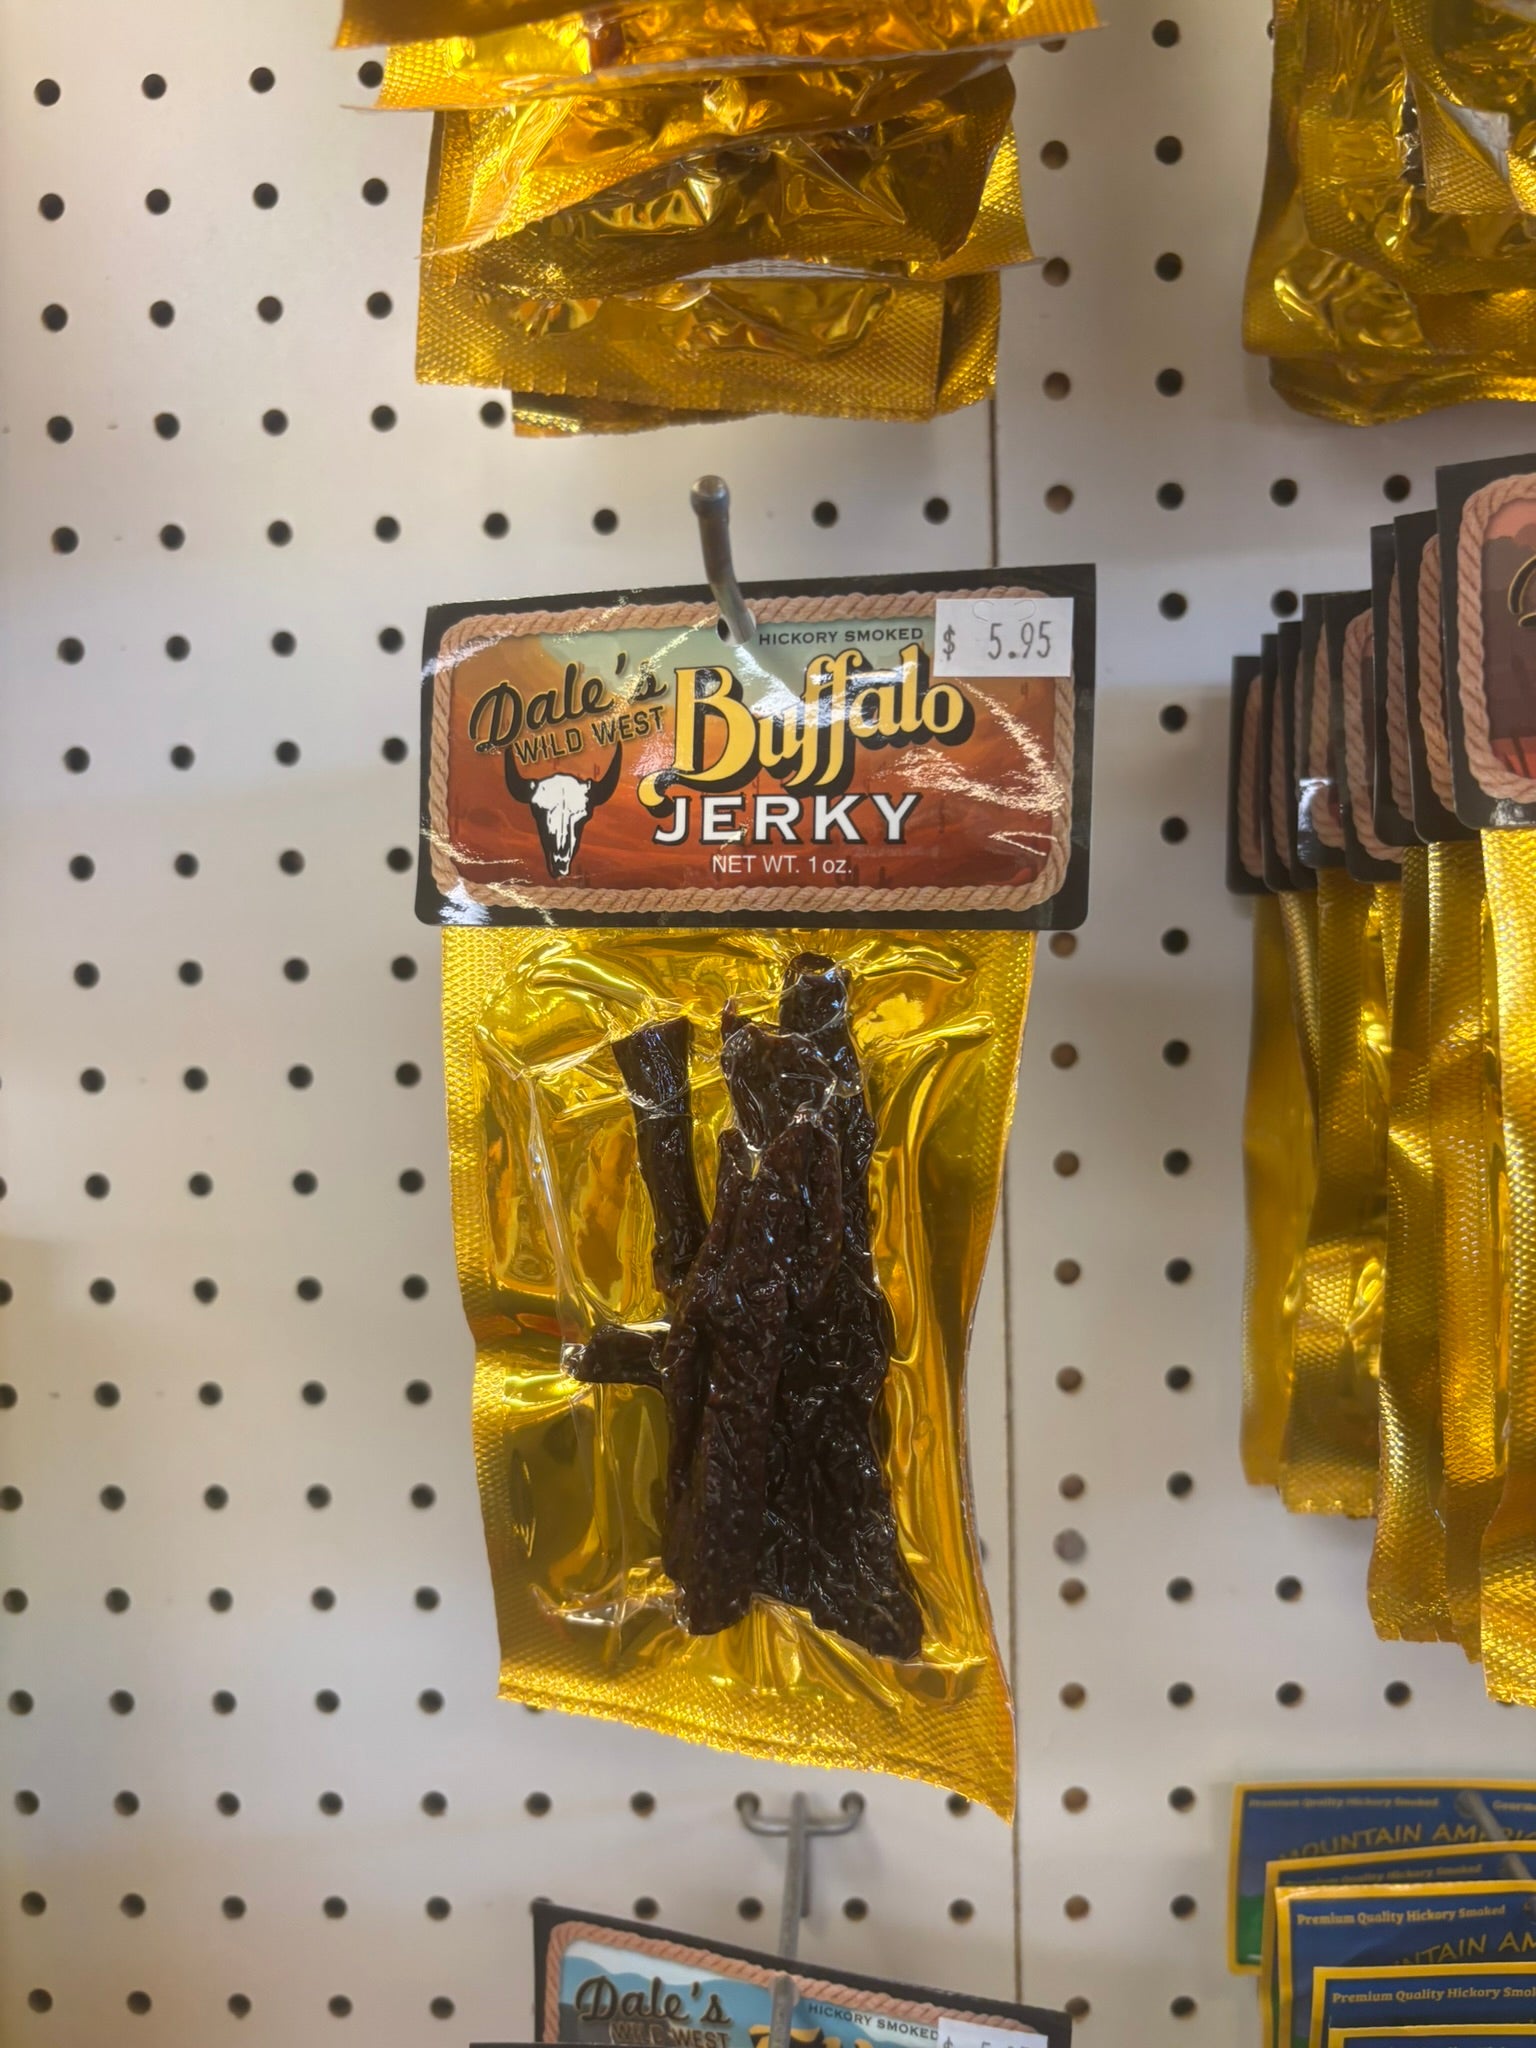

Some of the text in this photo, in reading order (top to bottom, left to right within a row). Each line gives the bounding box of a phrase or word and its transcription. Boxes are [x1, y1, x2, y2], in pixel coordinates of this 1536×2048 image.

[759, 627, 924, 645] HICKORY SMOKED
[943, 621, 1052, 660] $ 5.95
[468, 651, 669, 753] Dale's
[513, 705, 665, 765] WILD WEST
[637, 642, 975, 818] Buffalo
[652, 793, 921, 846] JERKY
[713, 854, 756, 873] NET
[762, 855, 800, 873] WT.
[1278, 1823, 1421, 1857] OUNTAIN
[1296, 1912, 1355, 1925] Premium
[1357, 1910, 1403, 1925] Quality
[1406, 1908, 1456, 1922] Hickory
[1458, 1905, 1506, 1918] Smoked
[575, 1975, 732, 2025] Dale's
[1332, 1991, 1393, 2003] Premium
[1396, 1989, 1445, 2002] Quality
[1447, 1987, 1500, 2000] Hickory
[667, 2027, 729, 2048] WEST
[808, 2002, 873, 2026] HICKORY
[877, 2018, 939, 2041] SMOKED
